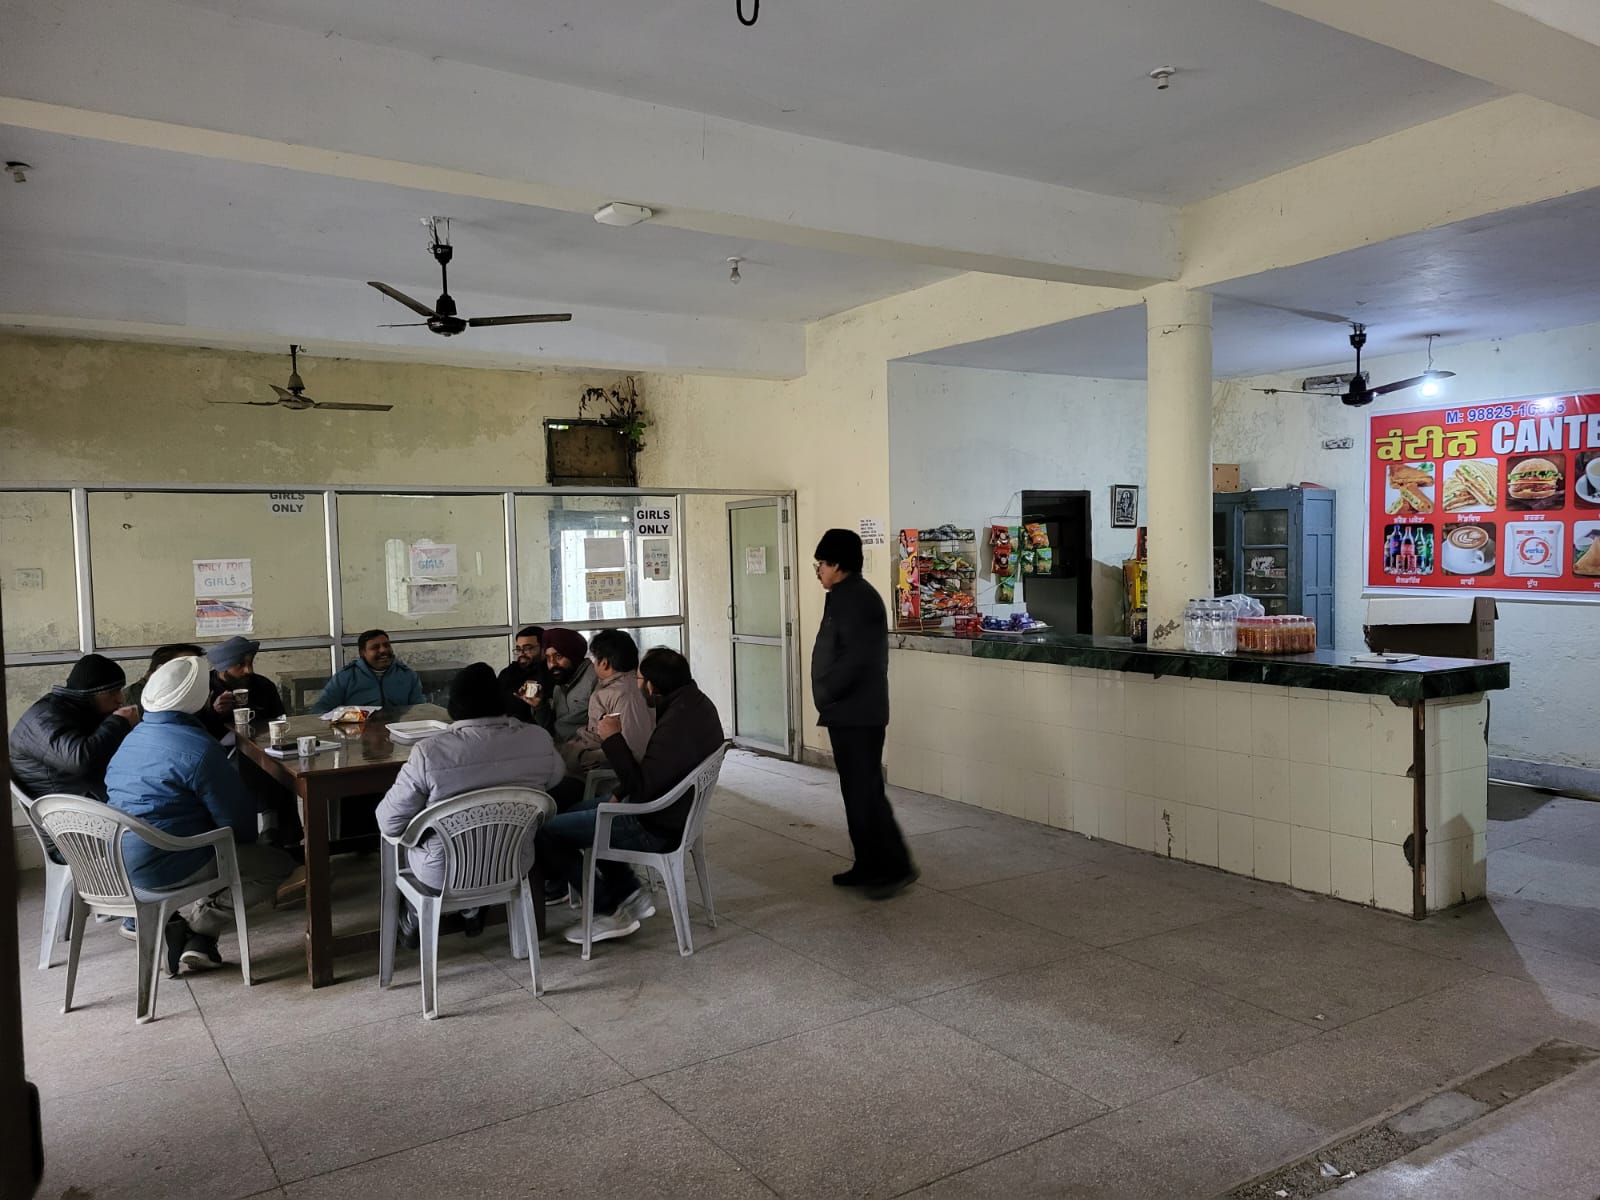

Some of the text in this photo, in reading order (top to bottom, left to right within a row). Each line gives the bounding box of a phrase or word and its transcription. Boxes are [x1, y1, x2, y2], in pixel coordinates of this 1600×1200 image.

[1446, 410, 1463, 424] M:
[272, 503, 304, 513] ONLY
[636, 510, 671, 520] GIRLS
[638, 524, 669, 534] ONLY
[204, 576, 237, 587] GIRLS
